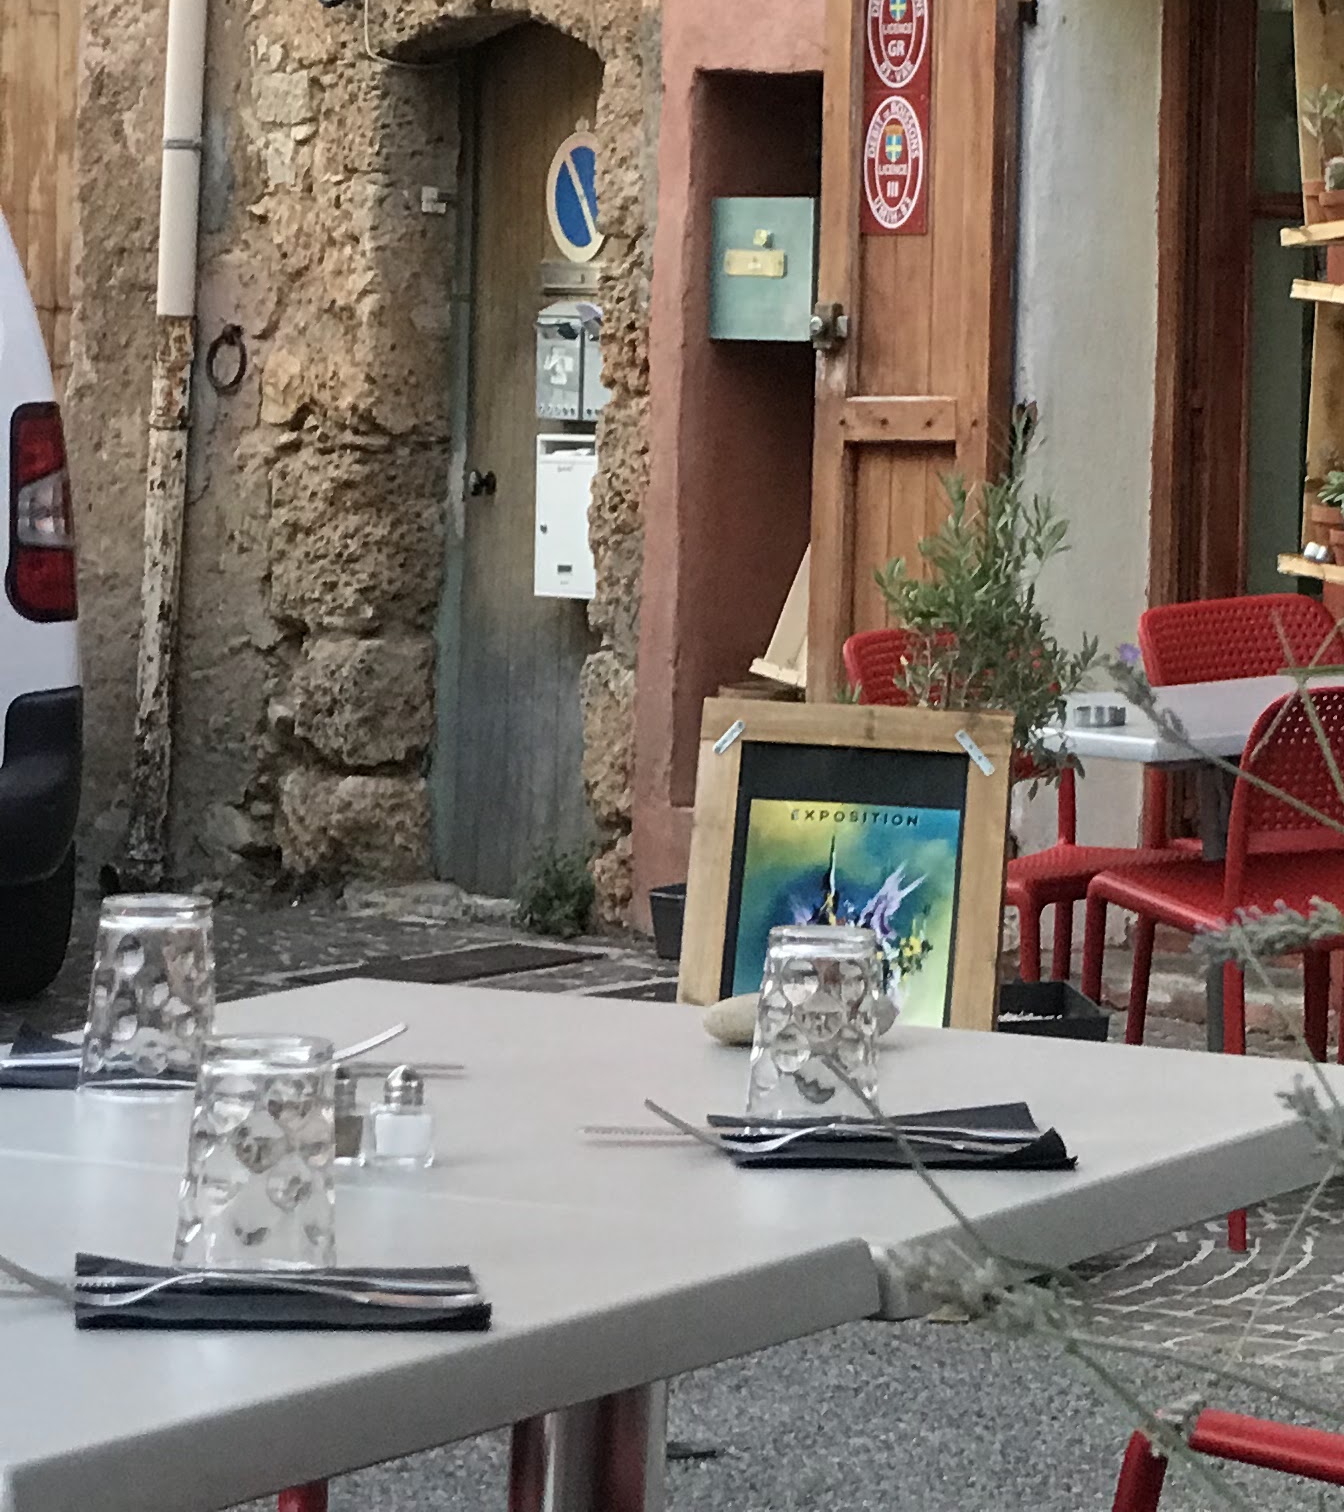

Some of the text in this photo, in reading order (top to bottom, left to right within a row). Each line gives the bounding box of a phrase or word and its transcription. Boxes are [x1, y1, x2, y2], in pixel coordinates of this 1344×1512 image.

[887, 39, 906, 57] GR
[886, 181, 899, 198] III
[791, 808, 919, 827] EXPOSITION
